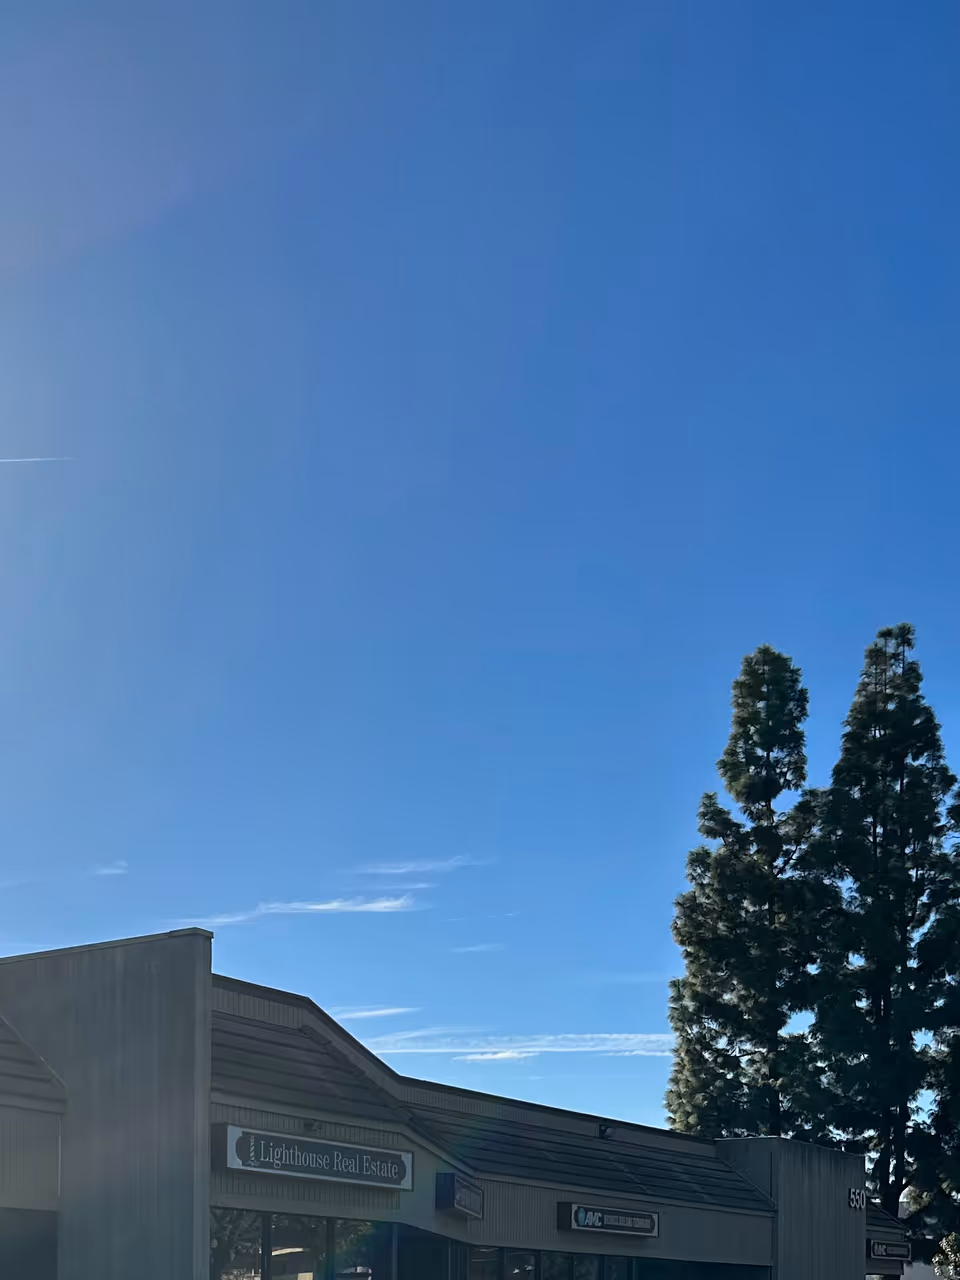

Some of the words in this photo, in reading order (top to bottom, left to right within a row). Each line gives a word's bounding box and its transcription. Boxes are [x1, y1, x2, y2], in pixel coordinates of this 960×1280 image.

[259, 1140, 330, 1170] Lighthouse
[332, 1151, 361, 1173] Real
[363, 1156, 400, 1179] Estate
[850, 1188, 866, 1209] 550
